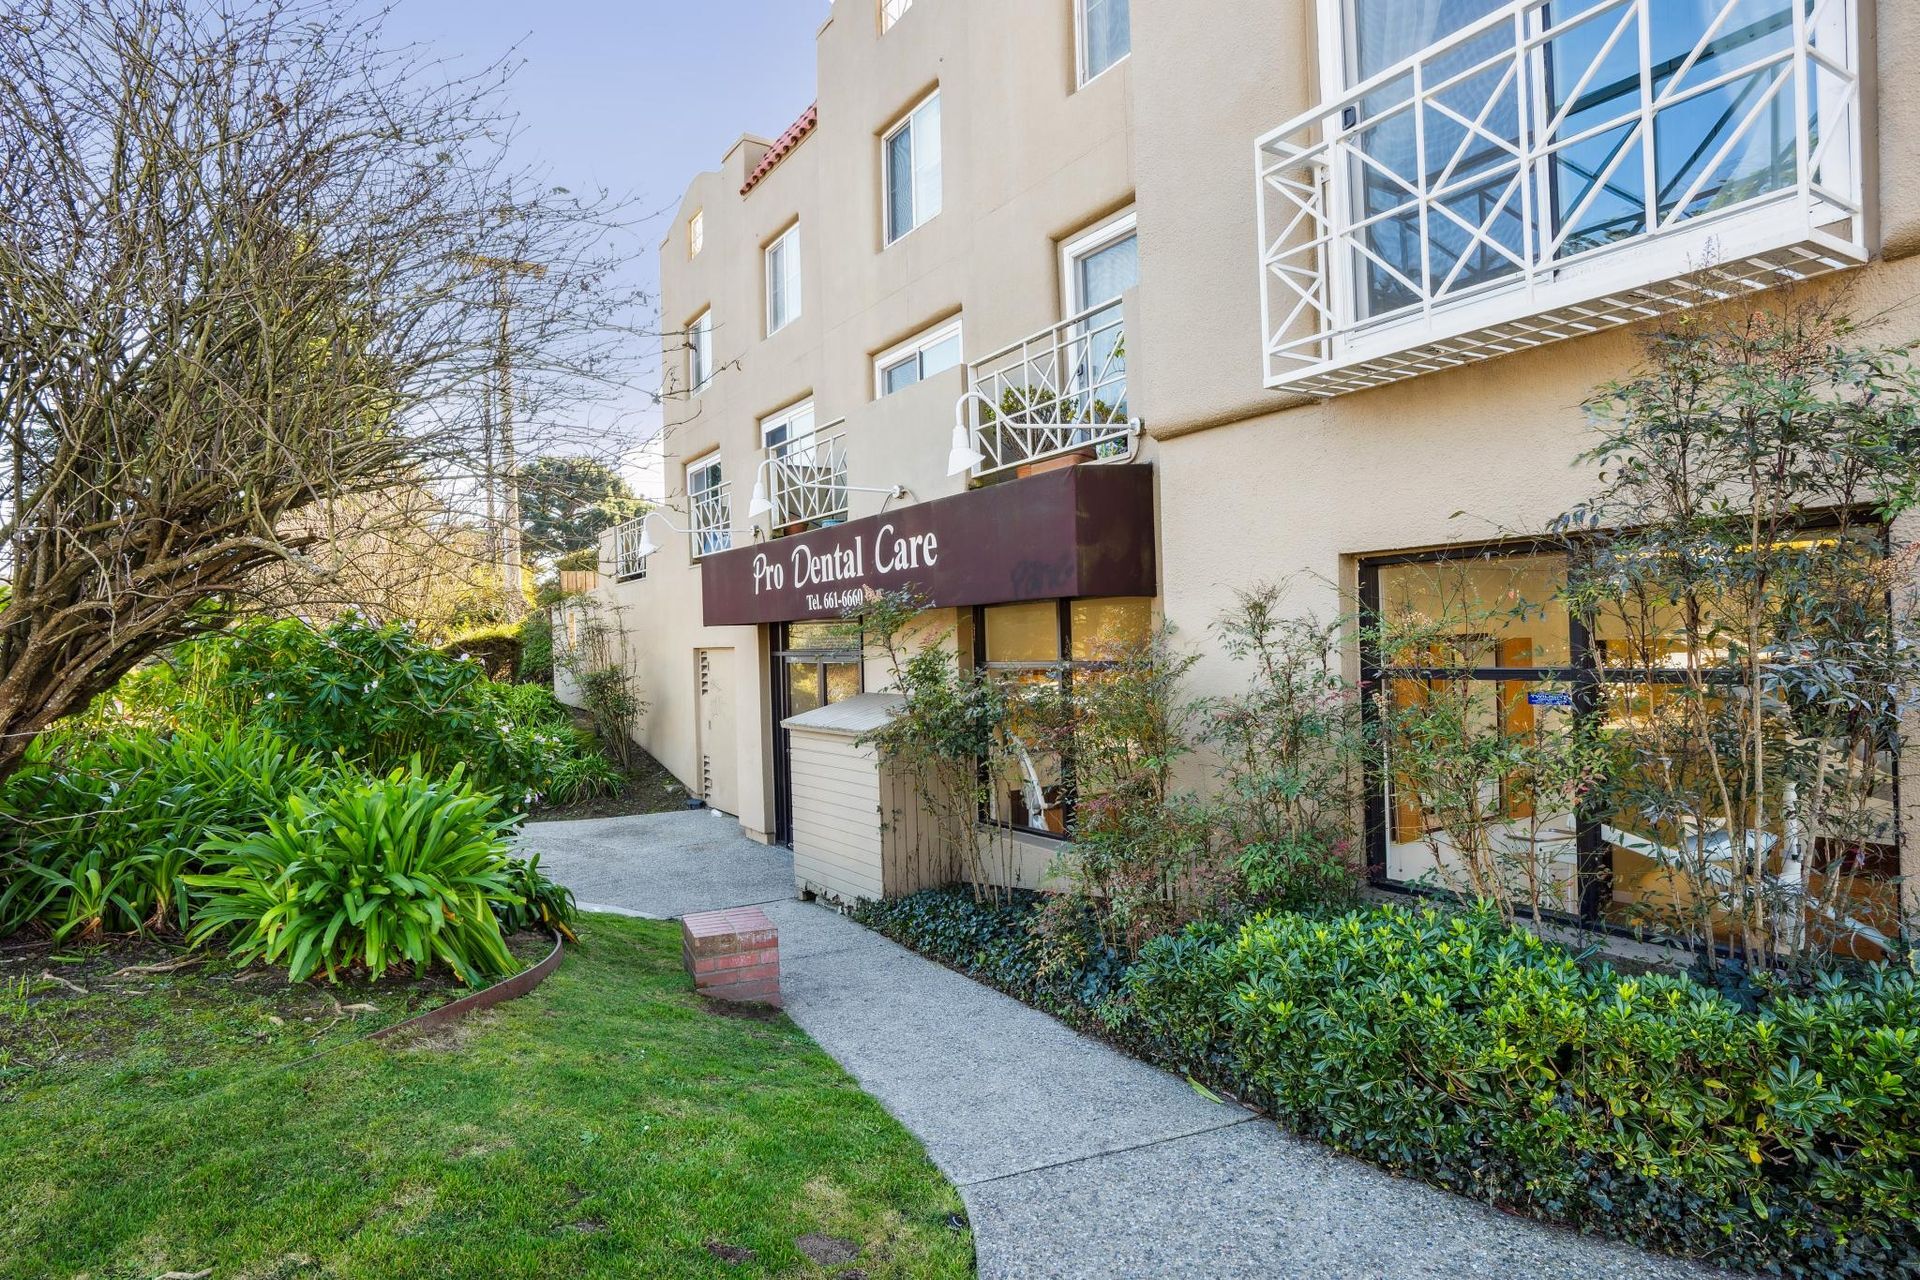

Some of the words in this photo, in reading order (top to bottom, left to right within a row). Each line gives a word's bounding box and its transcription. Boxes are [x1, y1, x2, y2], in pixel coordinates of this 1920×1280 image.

[753, 553, 783, 595] Pro
[791, 536, 864, 589] Dental
[875, 524, 938, 574] Care
[806, 593, 822, 611] Tel.
[823, 588, 864, 610] 661-6660
